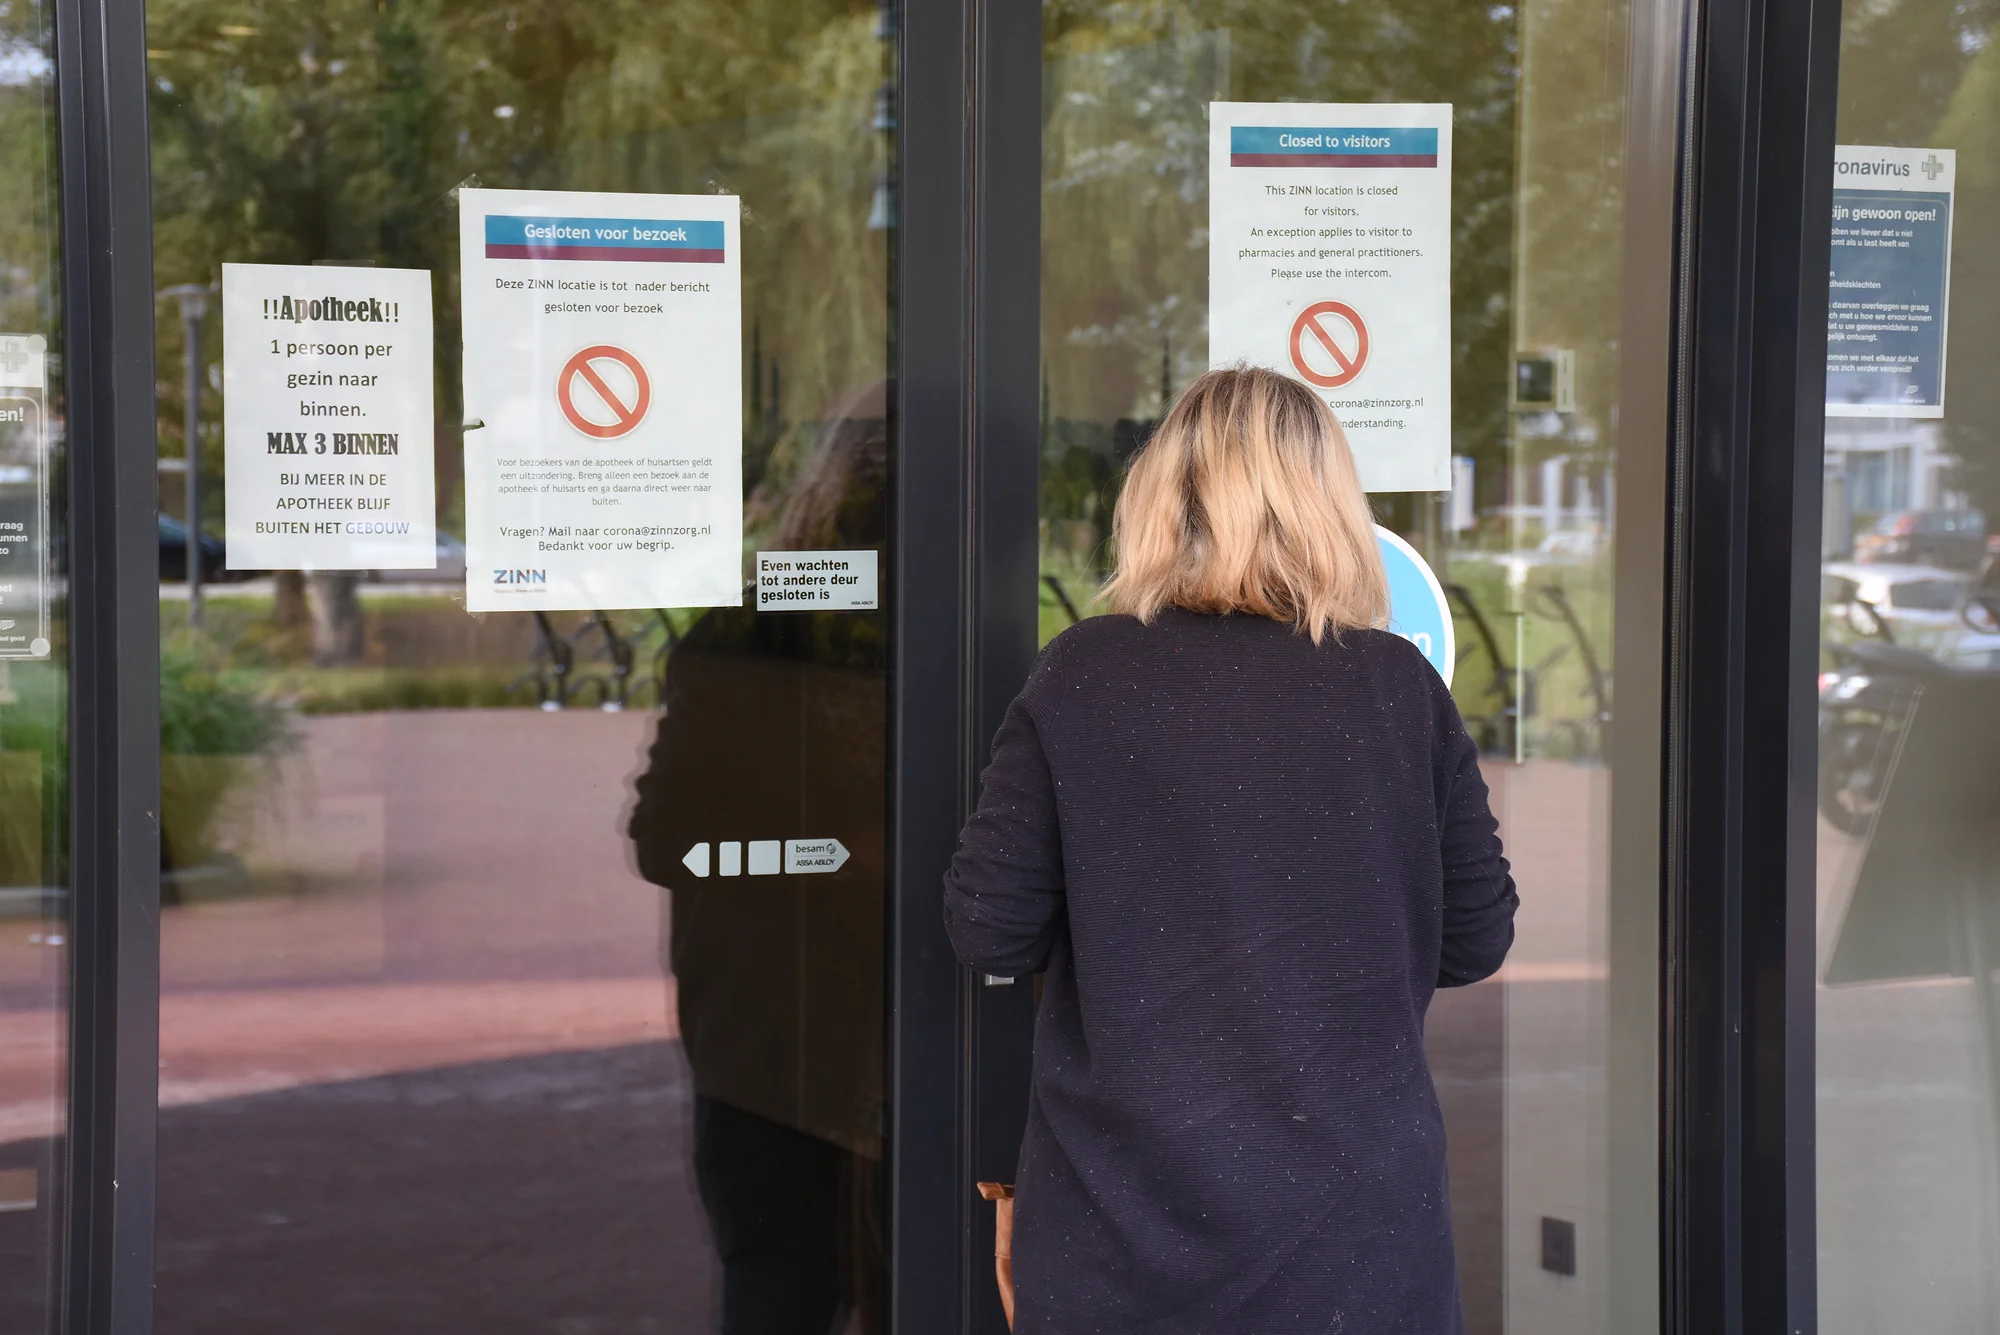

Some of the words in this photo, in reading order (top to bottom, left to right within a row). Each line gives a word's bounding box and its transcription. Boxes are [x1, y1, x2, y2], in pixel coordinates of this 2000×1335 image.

[1279, 134, 1322, 148] Closed
[1326, 136, 1338, 147] to
[1343, 135, 1390, 148] visitors
[1266, 186, 1286, 195] This
[1290, 186, 1312, 195] ZINN
[1315, 186, 1353, 195] location
[1357, 186, 1364, 195] is
[1367, 186, 1398, 195] closed
[1304, 206, 1317, 216] for
[1322, 207, 1359, 216] visitors.
[1853, 209, 1901, 221] gewoon
[1905, 209, 1936, 222] open!
[524, 224, 590, 240] Gesloten
[595, 228, 628, 240] voor
[633, 227, 687, 242] bezoek
[1250, 228, 1263, 237] An
[1267, 228, 1315, 239] exception
[1319, 228, 1352, 239] applies
[1356, 229, 1365, 237] to
[1369, 228, 1399, 237] visitor
[1402, 228, 1412, 236] to
[1861, 228, 1881, 236] liever
[1882, 228, 1894, 237] dat
[1901, 229, 1913, 237] niet
[1864, 239, 1877, 247] last
[1880, 239, 1896, 247] heeft
[1239, 248, 1294, 259] pharmacies
[1298, 248, 1315, 257] and
[1319, 248, 1354, 259] general
[1358, 248, 1423, 259] practitioners.
[1272, 269, 1302, 278] Please
[1326, 269, 1341, 278] the
[1345, 269, 1391, 278] intercom.
[496, 279, 523, 289] Deze
[528, 279, 554, 290] ZINN
[558, 280, 595, 290] locatie
[600, 281, 608, 290] is
[612, 281, 627, 291] tot
[635, 281, 666, 292] nader
[670, 281, 710, 292] bericht
[263, 296, 398, 324] !!Apotheek!!
[544, 302, 591, 314] gesloten
[595, 305, 619, 313] voor
[624, 303, 663, 313] bezoek
[1832, 301, 1860, 309] daarvan
[1861, 302, 1899, 311] overleggen
[270, 340, 280, 354] 1
[287, 342, 358, 358] persoon
[365, 342, 392, 359] per
[287, 371, 333, 389] gezin
[340, 374, 377, 386] naar
[300, 401, 366, 417] binnen.
[1330, 398, 1423, 409] corona@zinnzorg.nl
[1340, 419, 1406, 429] nderstanding.
[267, 433, 307, 454] MAX
[315, 433, 326, 454] 3
[333, 433, 398, 455] BINNEN
[519, 458, 563, 466] bezoekers
[583, 458, 593, 466] de
[595, 458, 633, 468] apotheek
[636, 458, 645, 466] of
[648, 458, 689, 466] huisartsen
[692, 458, 712, 468] geldt
[280, 474, 299, 485] BIJ
[305, 474, 345, 485] MEER
[349, 474, 365, 485] IN
[369, 474, 386, 485] DE
[519, 471, 575, 481] uitzondering.
[578, 471, 602, 481] Breng
[605, 471, 630, 479] alleen
[651, 471, 680, 479] bezoek
[699, 471, 709, 479] de
[498, 484, 538, 494] apotheek
[541, 484, 550, 492] of
[552, 484, 585, 492] huisarts
[601, 486, 610, 494] ga
[613, 484, 642, 492] daarna
[644, 484, 668, 492] direct
[276, 498, 353, 510] APOTHEEK
[358, 498, 390, 510] BLIJF
[256, 522, 309, 534] BUITEN
[315, 522, 341, 534] HET
[346, 522, 409, 534] GEBOUW
[500, 526, 545, 538] Vragen?
[548, 526, 571, 536] Mail
[575, 528, 599, 536] naar
[603, 525, 711, 537] corona@zinnzorg.nl
[539, 541, 584, 551] Bedankt
[636, 540, 674, 552] begrip.
[761, 560, 791, 571] Even
[795, 560, 849, 570] wachten
[494, 569, 546, 584] ZINN
[761, 575, 779, 586] tot
[783, 574, 826, 585] andere
[831, 574, 858, 585] deur
[761, 589, 815, 603] gesloten
[820, 589, 830, 599] is
[796, 844, 825, 853] besam
